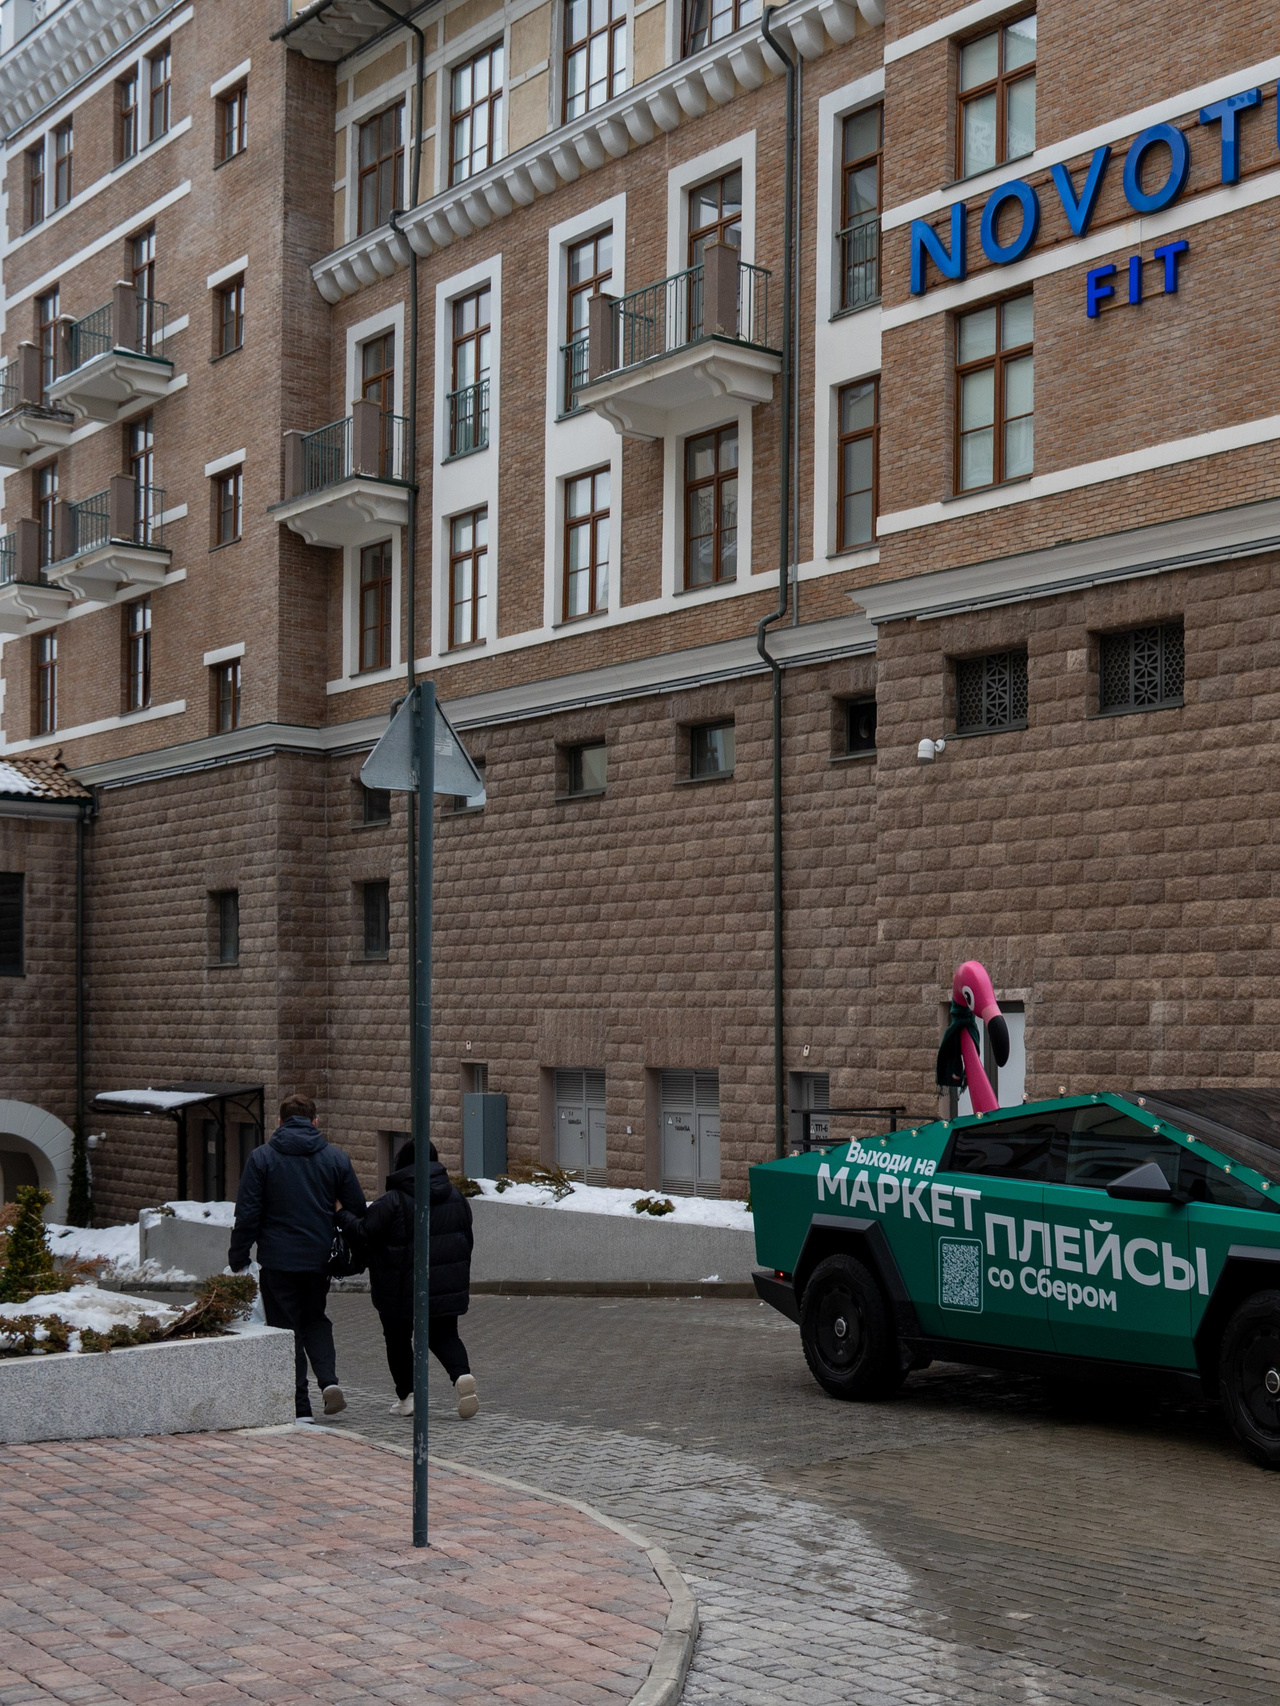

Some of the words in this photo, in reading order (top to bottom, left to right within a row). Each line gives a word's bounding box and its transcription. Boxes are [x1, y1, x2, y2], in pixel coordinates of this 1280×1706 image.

[1086, 239, 1190, 319] FIT
[845, 1141, 912, 1174] Выходи
[913, 1158, 937, 1177] на
[817, 1163, 981, 1231] МАРКЕТ
[984, 1212, 1209, 1296] ПЛЕЙСЫ
[987, 1266, 1014, 1290] со
[1019, 1266, 1117, 1312] Сбером
